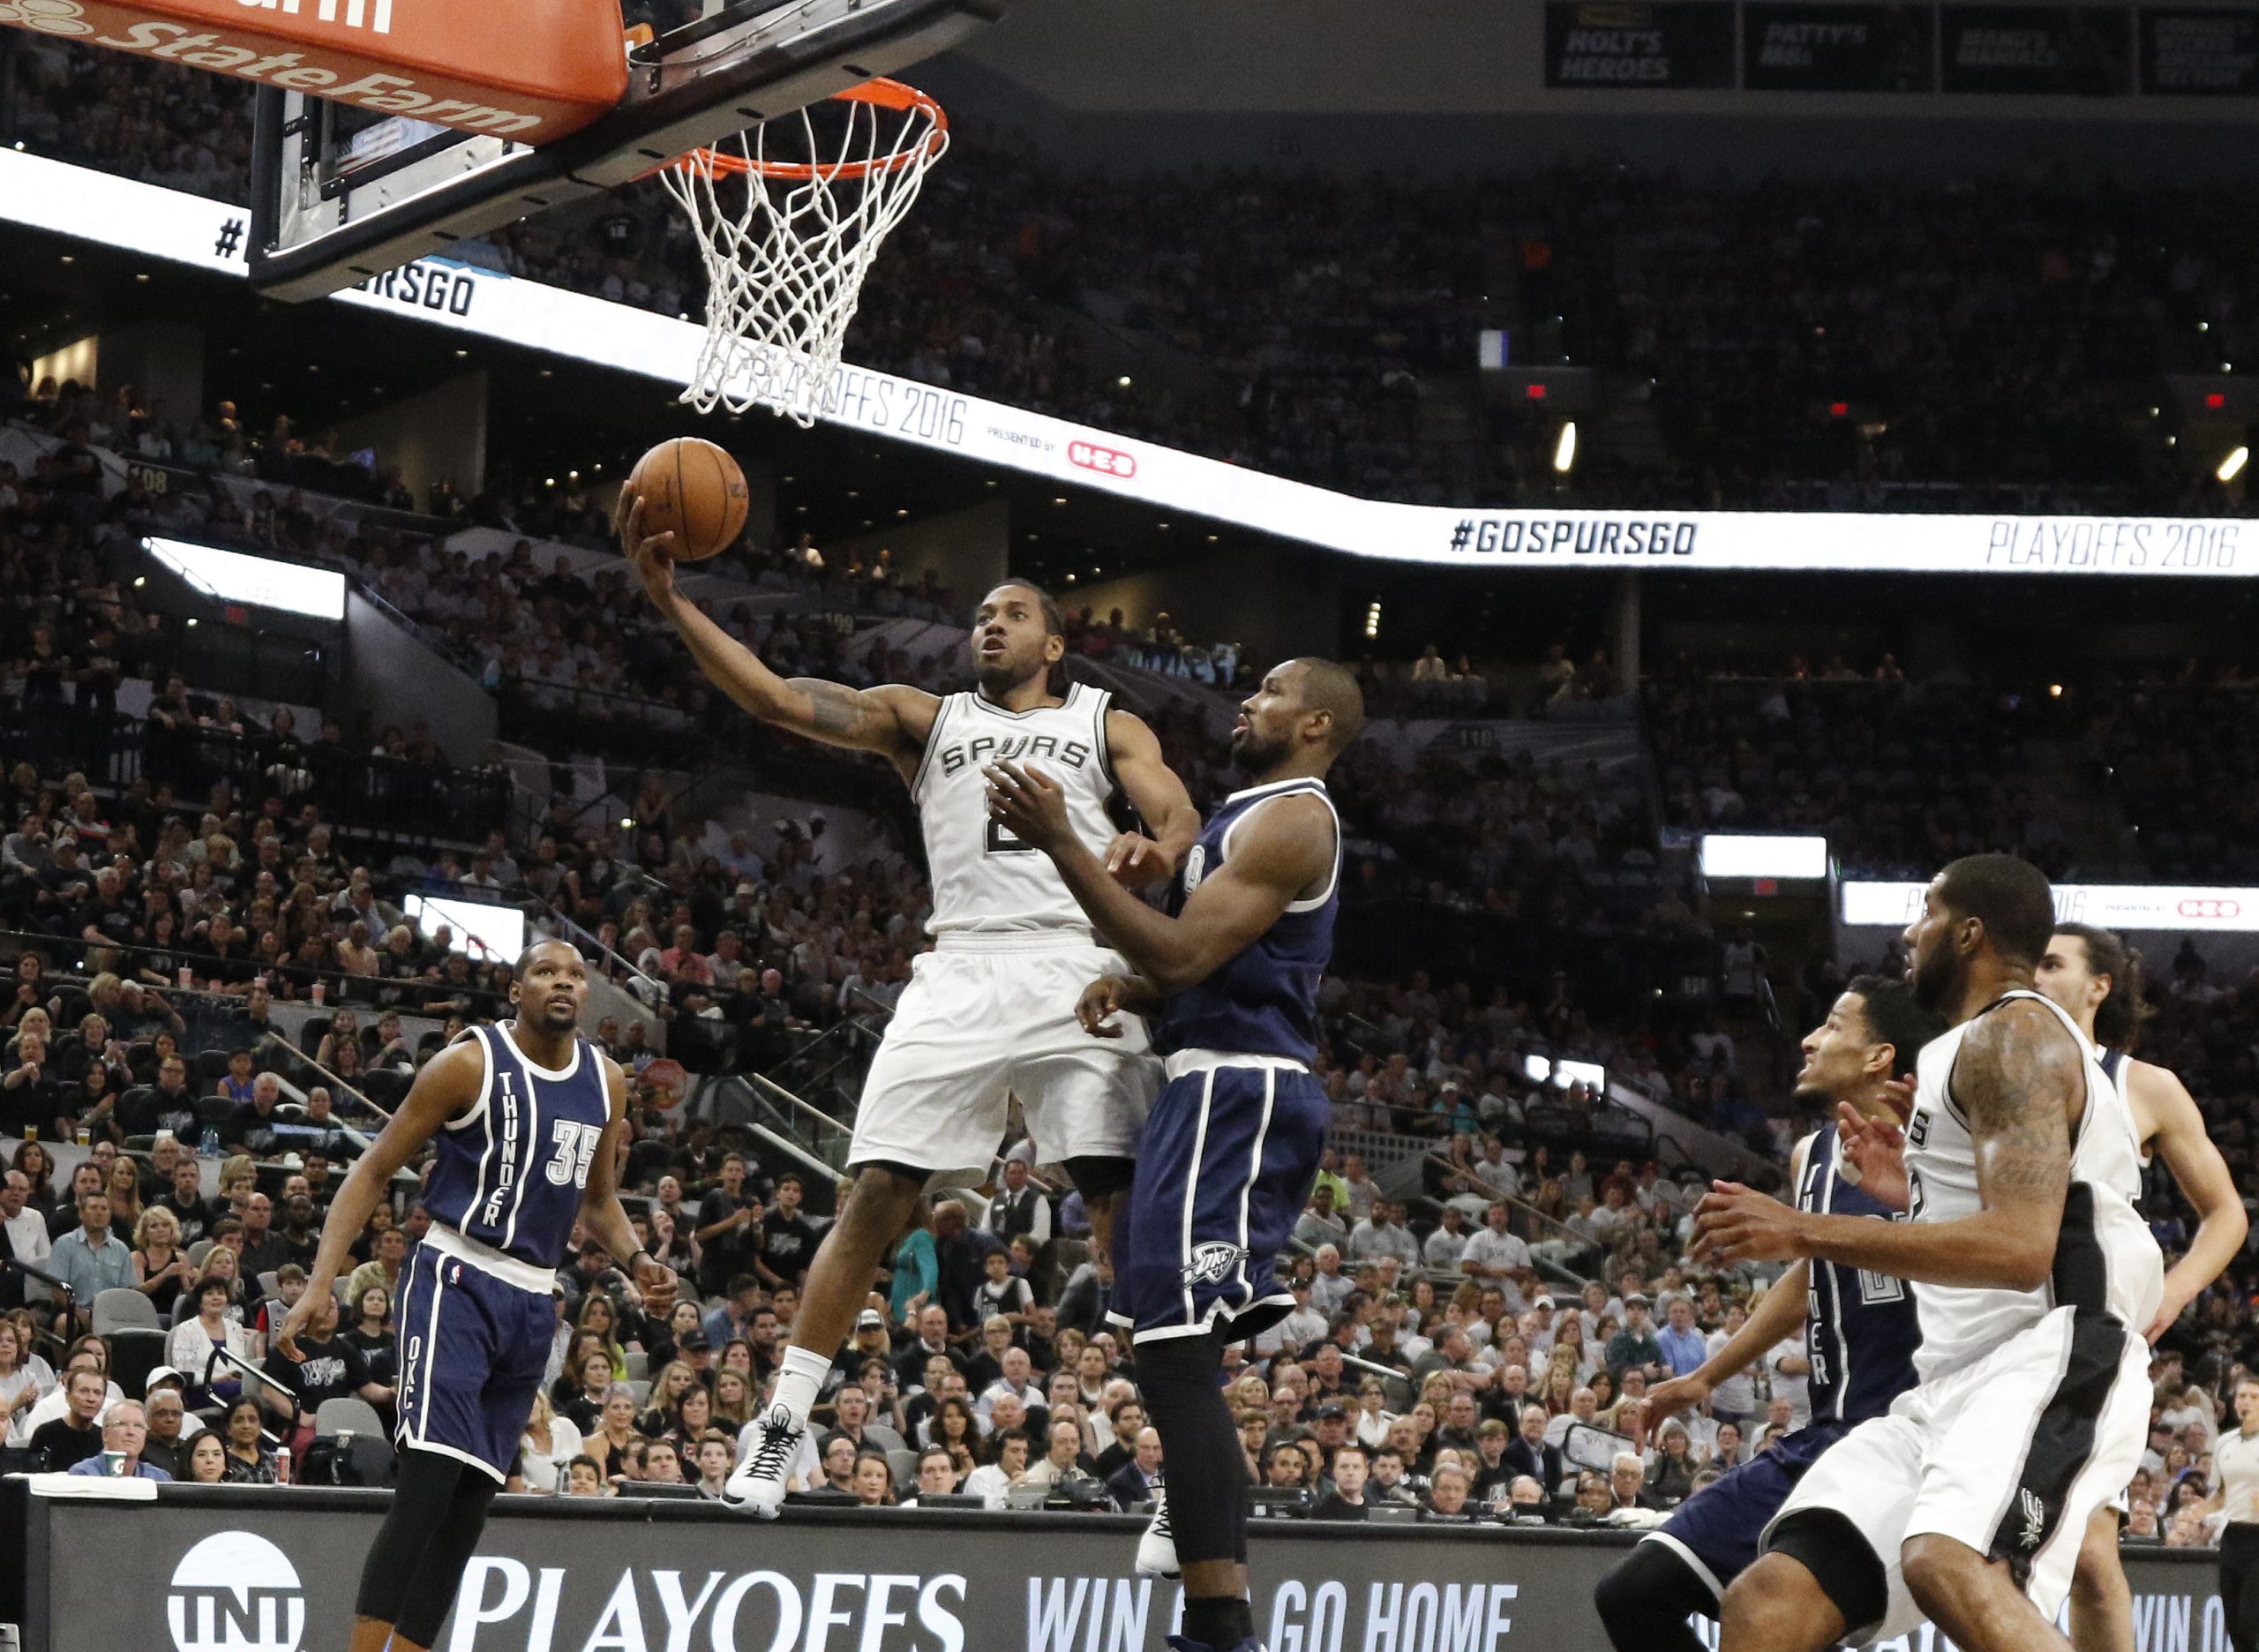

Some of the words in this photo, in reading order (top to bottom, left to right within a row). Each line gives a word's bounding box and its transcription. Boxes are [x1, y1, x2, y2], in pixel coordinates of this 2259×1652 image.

[95, 20, 339, 88] State
[319, 71, 544, 134] Farm
[1559, 56, 1671, 81] HEROES
[899, 386, 969, 447] 2016
[987, 425, 1042, 448] PRESENTED
[1450, 519, 1699, 555] #GOSPURSGO
[1985, 521, 2153, 567] PLAYOFFS
[2161, 524, 2240, 568] 2016
[942, 735, 1091, 778] SPURS
[481, 1071, 519, 1228] THUNDER
[545, 1118, 603, 1190] 35
[1194, 1250, 1230, 1276] OKC
[403, 1335, 421, 1410] OKC
[168, 1586, 305, 1645] TNT
[447, 1555, 968, 1652] PLAYOFFS
[1028, 1576, 1153, 1652] WIN
[1270, 1580, 1348, 1652] GO
[1364, 1581, 1520, 1652] HOME
